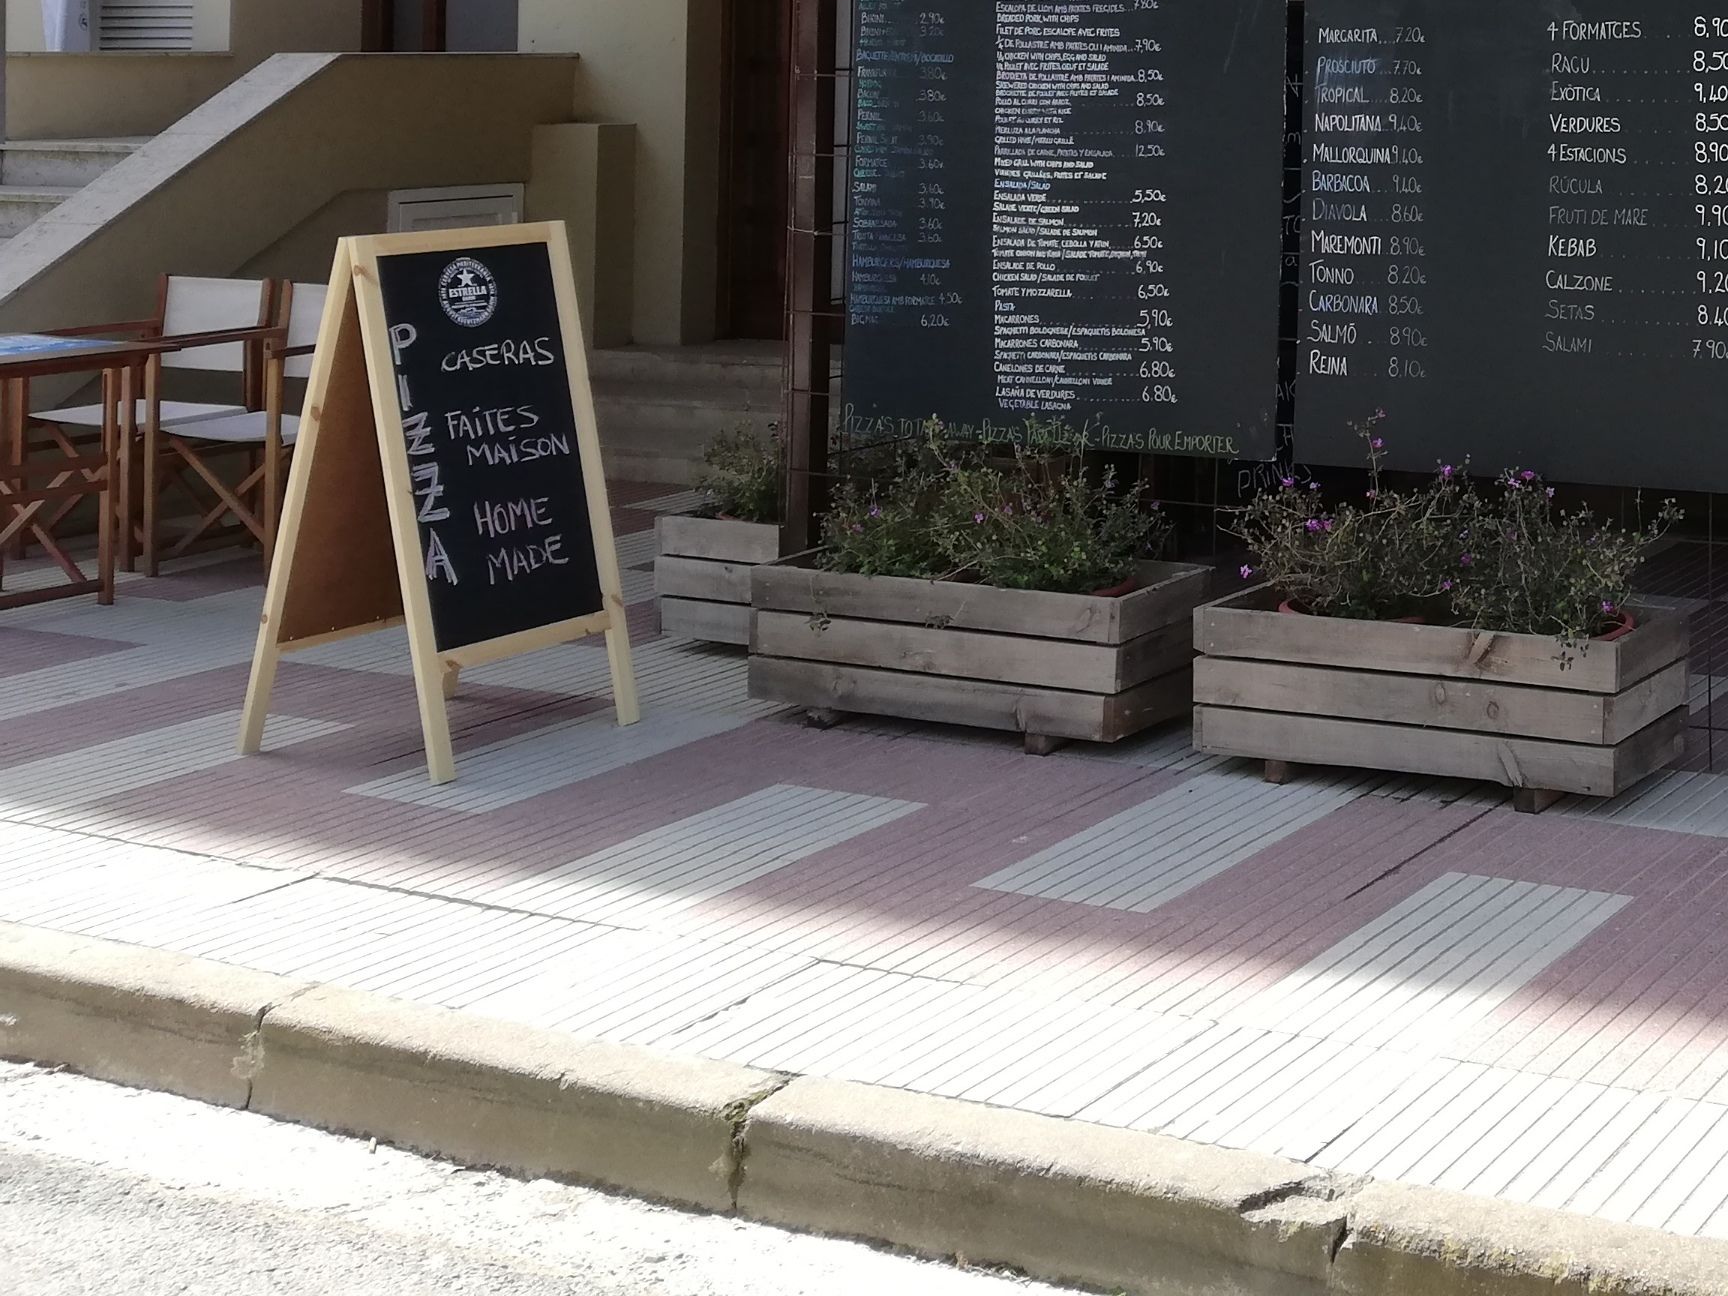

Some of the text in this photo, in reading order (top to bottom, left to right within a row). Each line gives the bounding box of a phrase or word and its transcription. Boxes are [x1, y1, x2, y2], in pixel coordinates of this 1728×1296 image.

[1318, 25, 1378, 45] MARGARITA
[1547, 22, 1559, 41] 4
[1562, 21, 1642, 40] FORMATGES
[1314, 83, 1370, 105] TROPICAL
[1314, 113, 1382, 133] NAPOLITANA
[1549, 114, 1621, 134] VERDURES
[1312, 143, 1391, 165] MALLORQUINA
[1547, 144, 1557, 162] 4
[1559, 146, 1627, 165] ESTACIONS
[1311, 169, 1371, 193] BARBACOA
[1311, 199, 1368, 223] DIAVOLA
[1591, 208, 1610, 226] DE
[1613, 207, 1648, 227] MARE
[1548, 235, 1597, 258] KEBAB
[1309, 259, 1354, 286] TONNO
[1546, 269, 1614, 293] CALZONE
[448, 285, 487, 298] ESTRELLA
[1308, 290, 1379, 316] CARBONARA
[1544, 299, 1595, 321] SETAS
[1542, 332, 1593, 354] SALAMI
[441, 337, 554, 372] CASERAS
[1309, 349, 1348, 378] REINA
[473, 497, 552, 538] HOME
[487, 534, 570, 585] MADE
